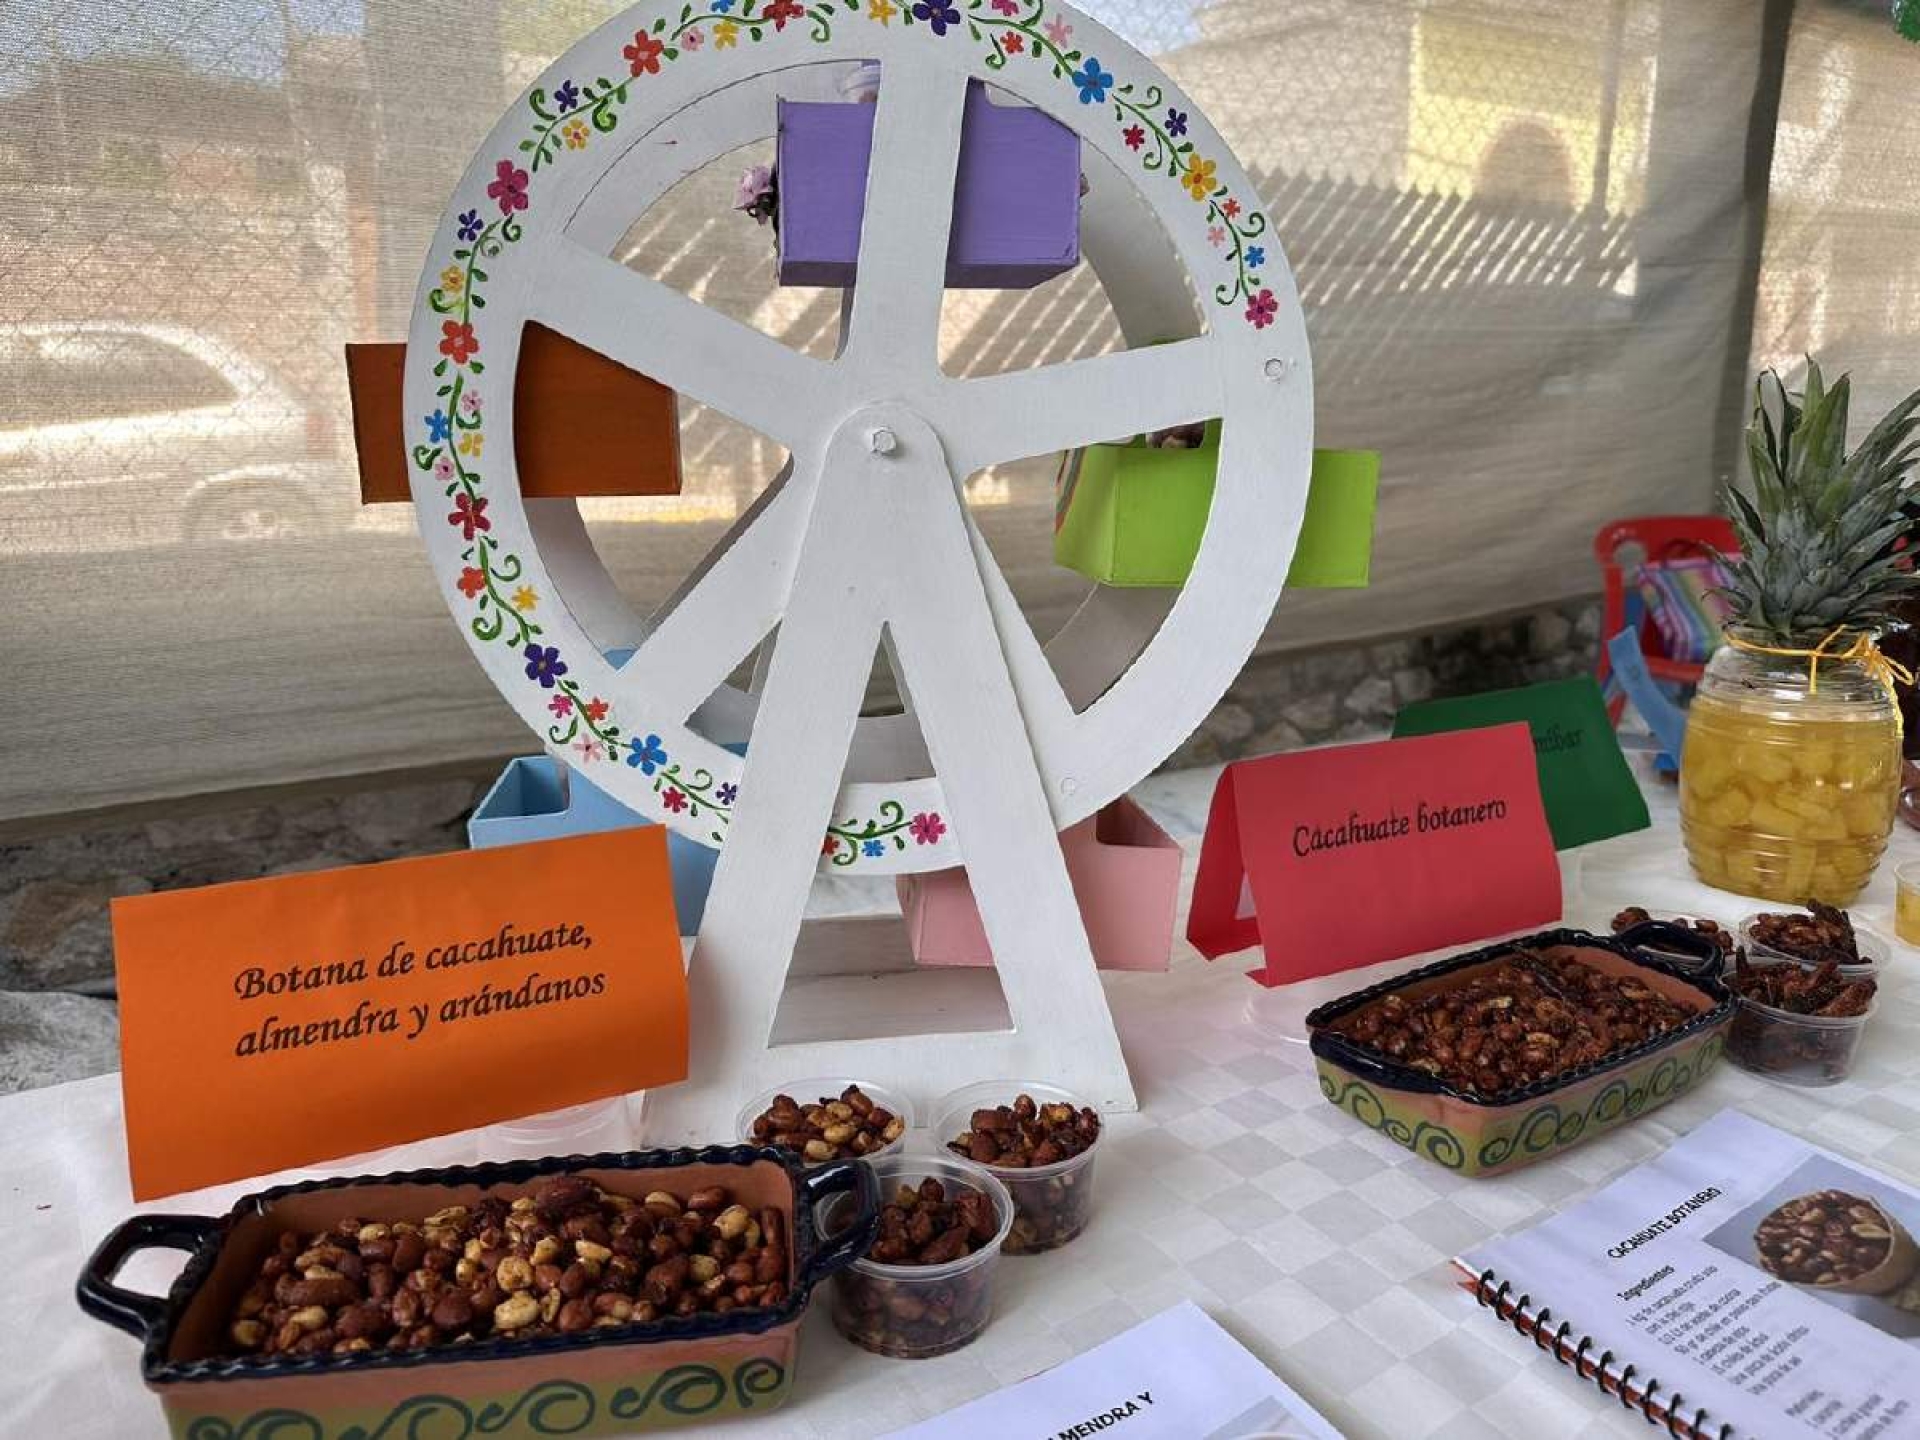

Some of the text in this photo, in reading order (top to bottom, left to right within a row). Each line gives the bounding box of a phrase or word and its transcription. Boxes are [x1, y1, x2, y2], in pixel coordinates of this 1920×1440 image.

[1293, 799, 1507, 857] Cacahuate botanero
[234, 922, 593, 999] Botana de cacahuate,
[235, 971, 606, 1057] almendra y arándanos
[1606, 1186, 1721, 1259] CACAHUATE BOTANERO
[1048, 1391, 1153, 1440] MENDRA Y
